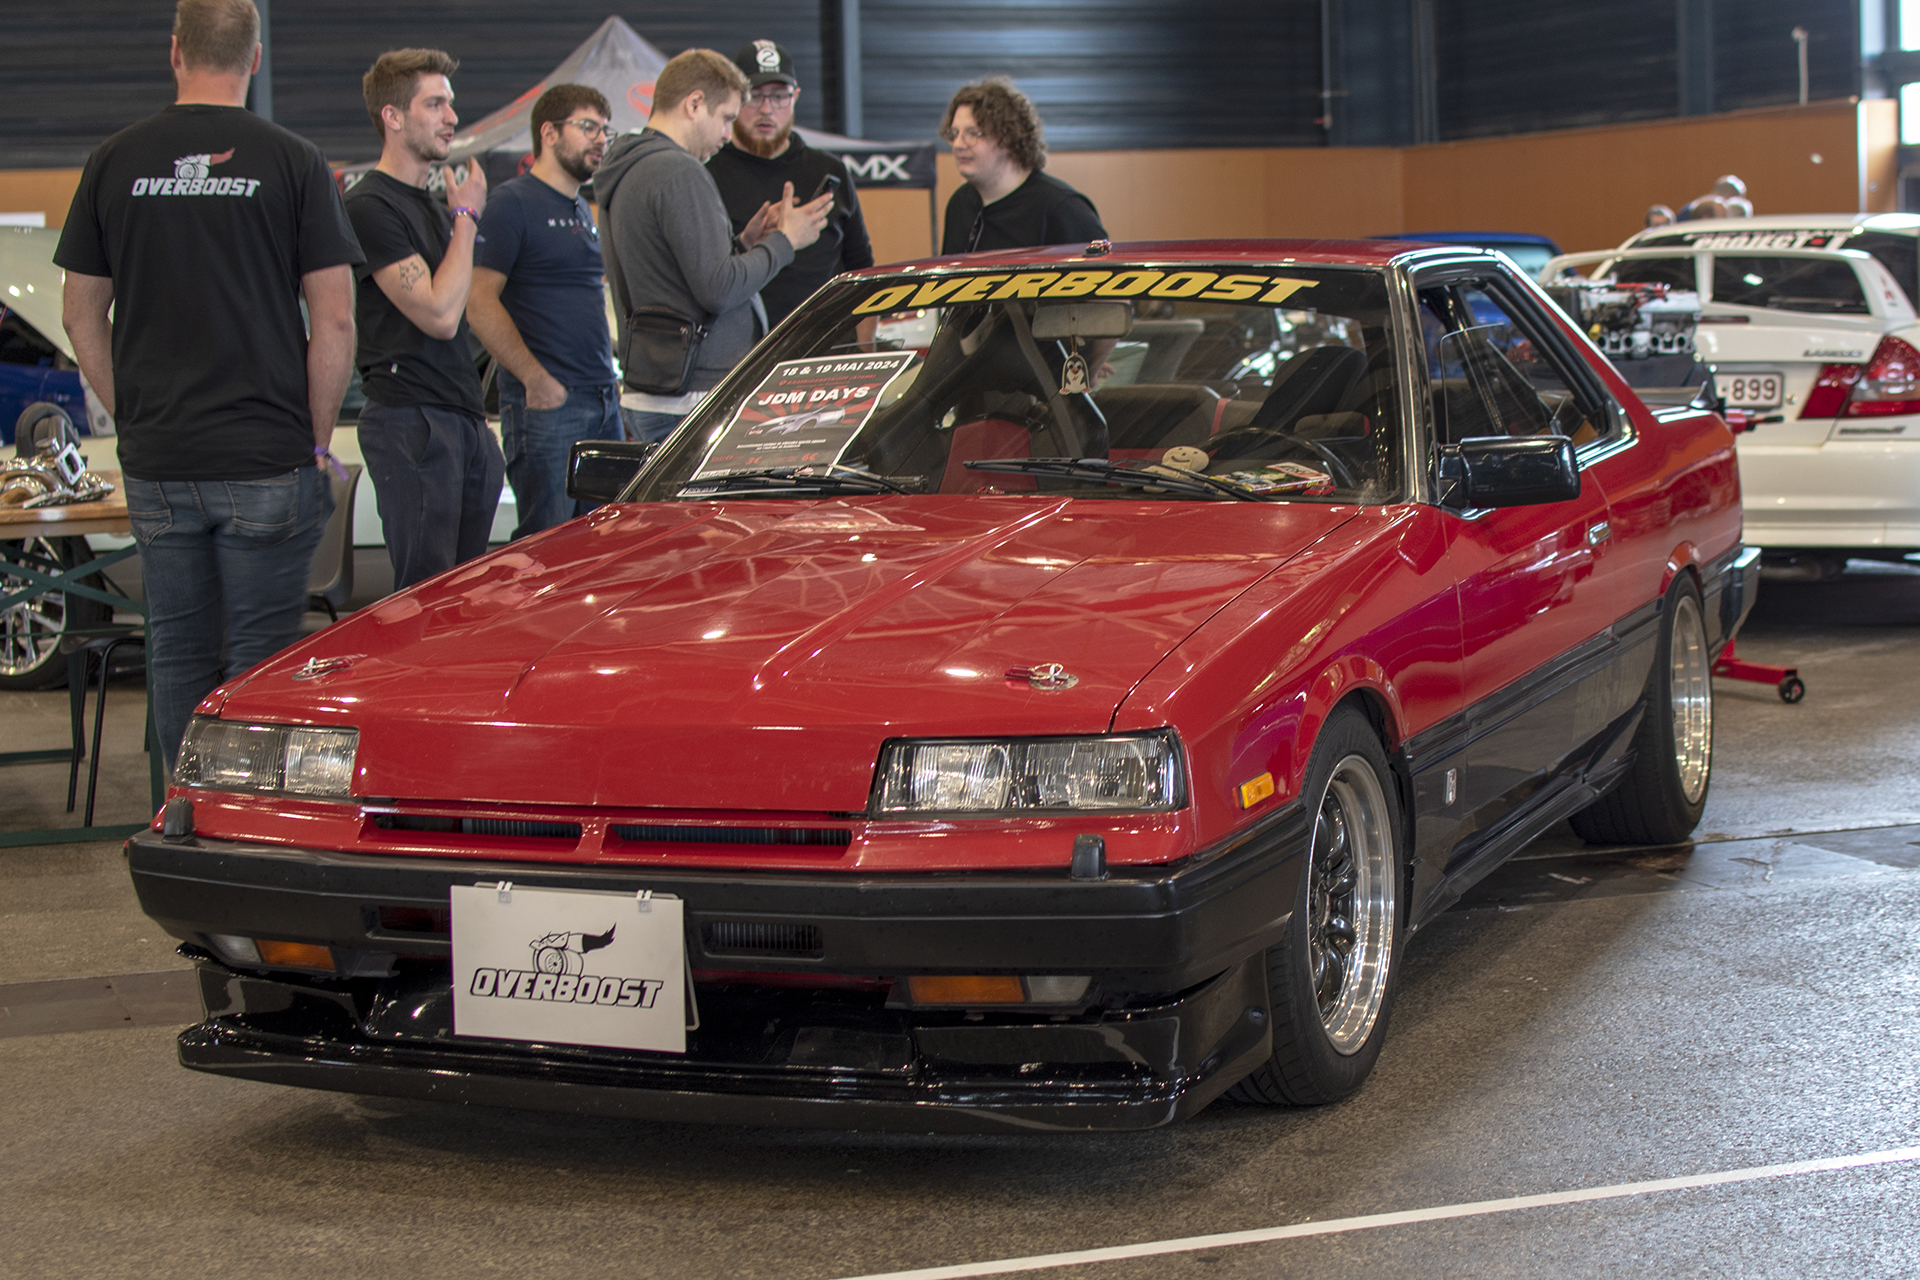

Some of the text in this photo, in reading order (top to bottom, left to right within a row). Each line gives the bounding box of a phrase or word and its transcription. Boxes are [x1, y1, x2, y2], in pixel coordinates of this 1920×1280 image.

[762, 49, 776, 63] 2
[131, 177, 261, 197] OVERBOOST
[851, 270, 1320, 315] OVERBOOST
[782, 360, 900, 377] 18 & 19 MAI 2024
[758, 386, 871, 406] JDM DAYS
[470, 967, 664, 1008] OVERBOOST
